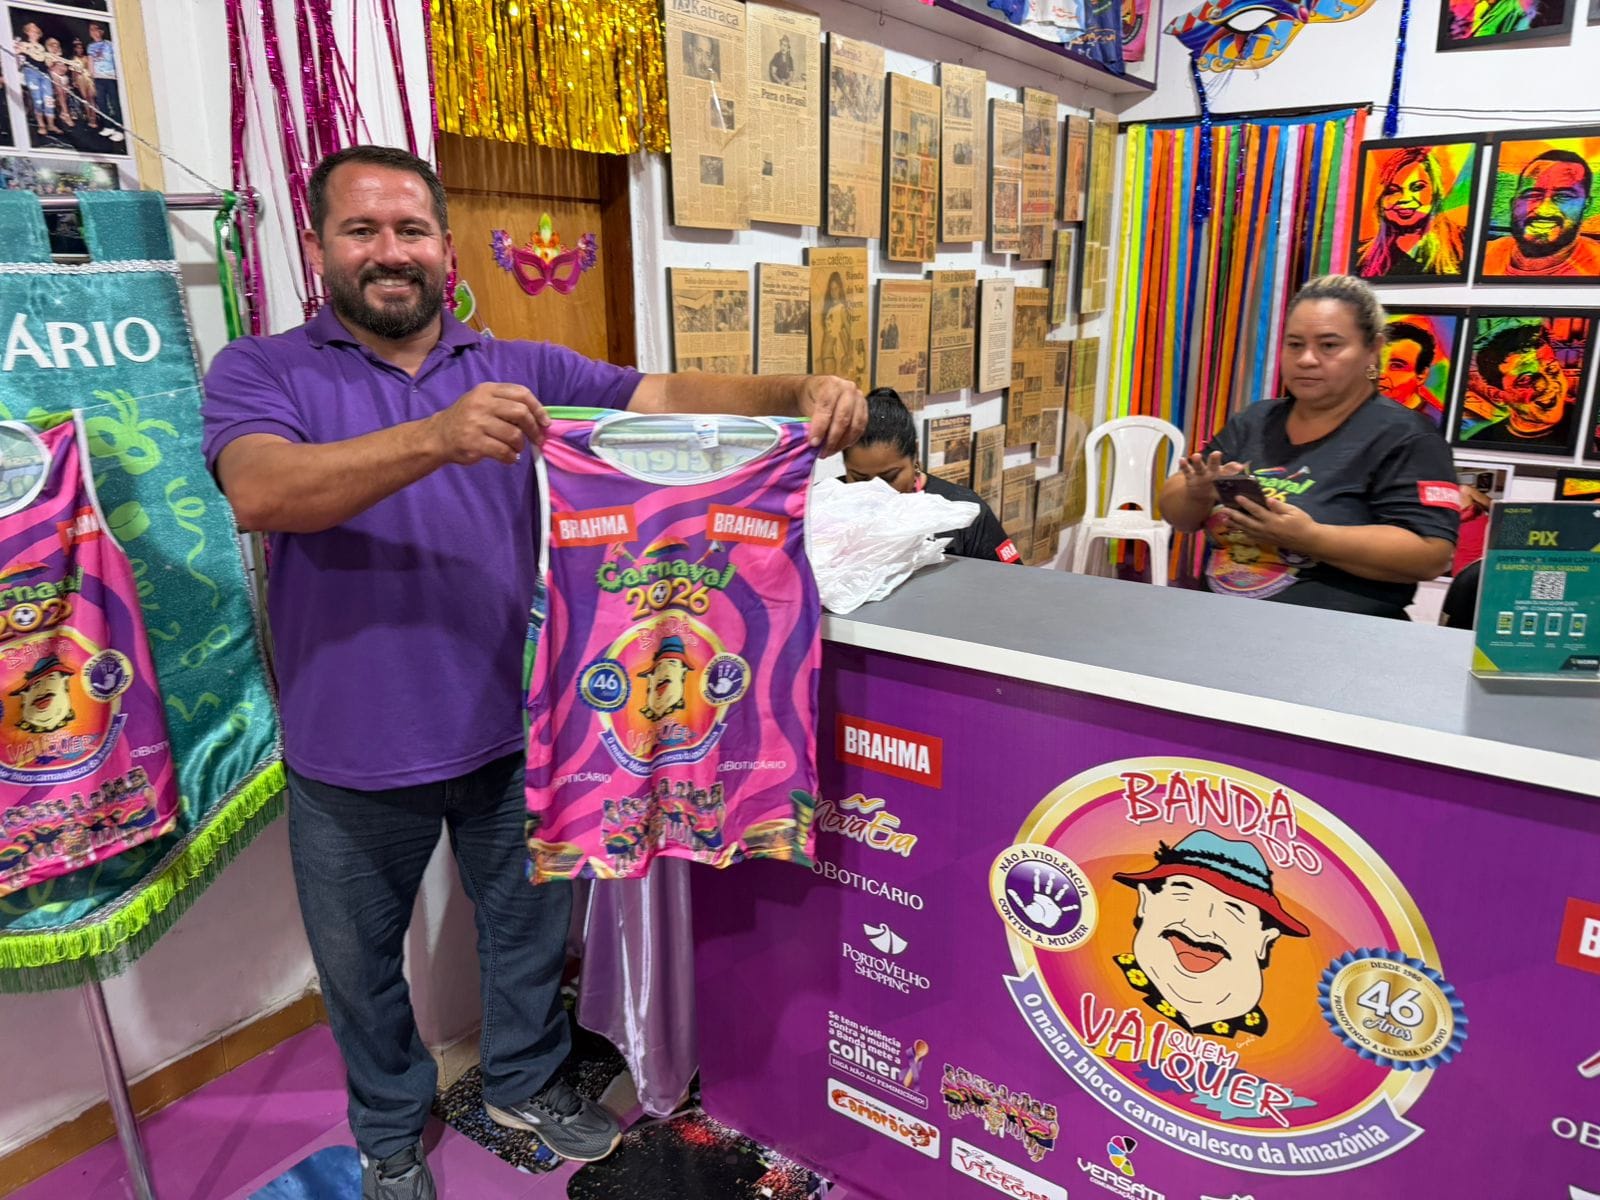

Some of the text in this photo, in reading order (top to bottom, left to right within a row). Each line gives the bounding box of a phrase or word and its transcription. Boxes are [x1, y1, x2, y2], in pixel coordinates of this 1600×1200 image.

[761, 88, 779, 102] Para
[558, 513, 630, 541] BRAHMA
[713, 512, 780, 540] BRAHMA
[1528, 530, 1560, 547] PIX
[596, 559, 738, 593] Carnaval
[625, 577, 711, 622] 2026
[593, 673, 619, 691] 46
[844, 725, 931, 775] BRAHMA
[1120, 771, 1297, 838] BANDA
[866, 811, 918, 857] Era
[1257, 829, 1323, 875] DO
[999, 853, 1020, 873] NÃO
[1032, 850, 1089, 898] VIOLÊNCIA
[998, 898, 1089, 946] CONTRA A MULHER
[855, 960, 910, 994] SHOPPING
[1370, 961, 1423, 982] DESDE 1980
[1357, 979, 1425, 1028] 46
[828, 1010, 902, 1048] Se tem violência
[828, 1020, 901, 1056] contra a mulher
[1080, 992, 1168, 1069] VAI
[1334, 994, 1371, 1046] PROMOVENDO
[1381, 1047, 1420, 1057] ALEGRIA
[1420, 1044, 1433, 1055] DO
[1362, 1016, 1414, 1041] Anos
[828, 1027, 901, 1065] a Banda mete a
[828, 1039, 901, 1081] colher
[1167, 1030, 1240, 1070] QUEM
[832, 1058, 849, 1071] DIGA
[849, 1065, 866, 1077] NÃO
[866, 1073, 877, 1082] AO
[1024, 993, 1391, 1165] O maior bloco carnavalesco da Amazônia
[1162, 1051, 1293, 1129] QUER
